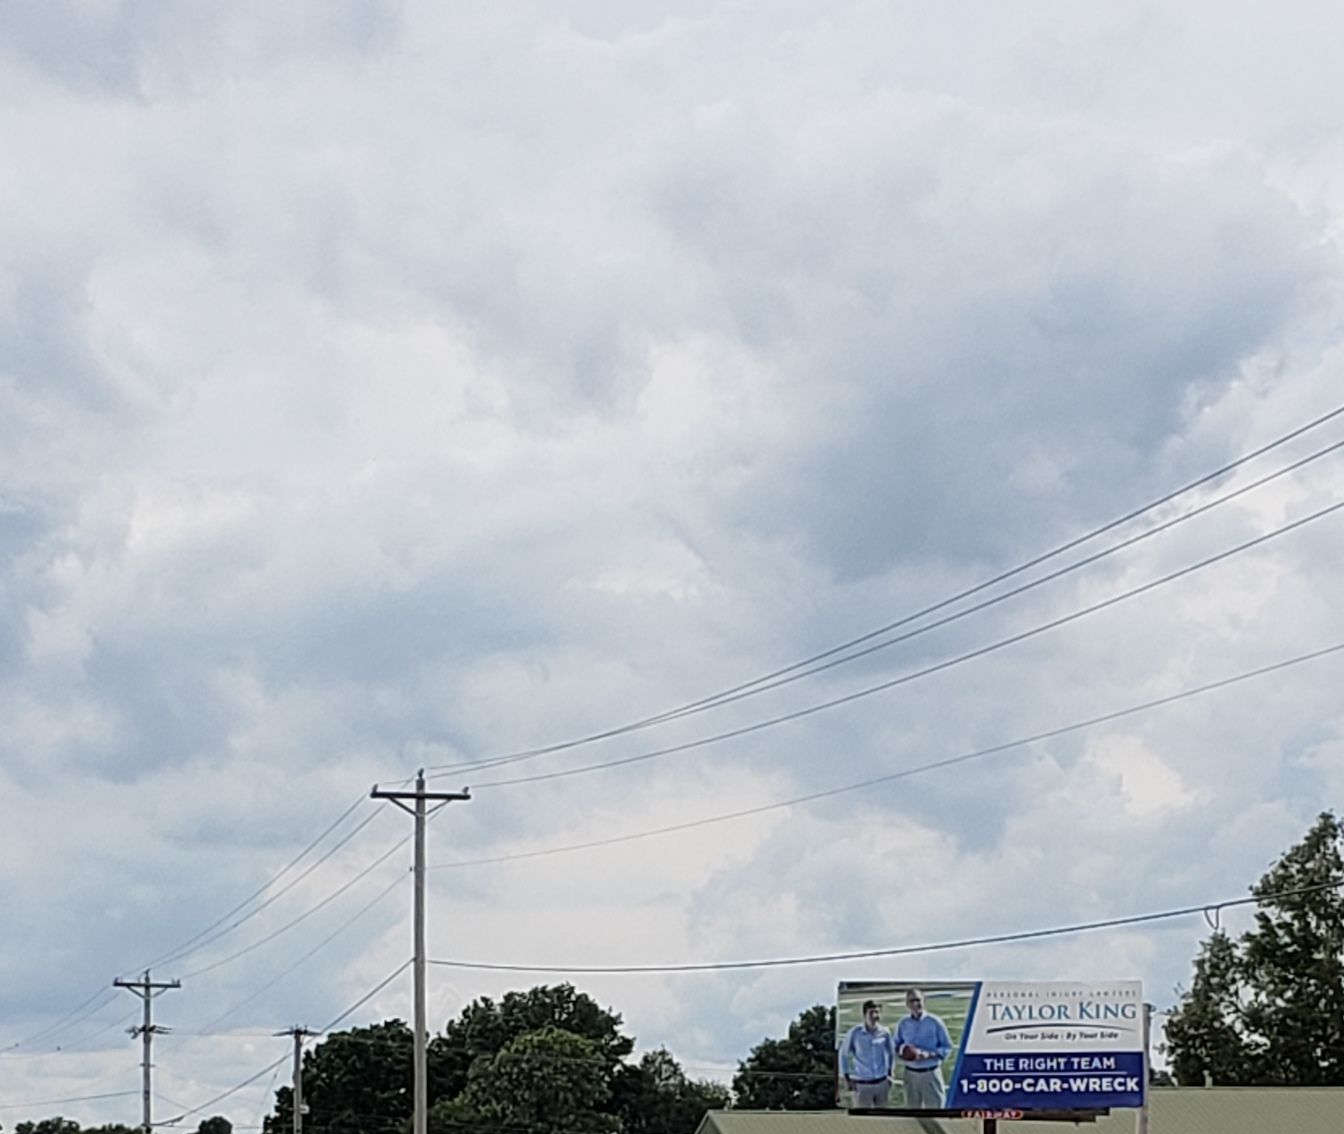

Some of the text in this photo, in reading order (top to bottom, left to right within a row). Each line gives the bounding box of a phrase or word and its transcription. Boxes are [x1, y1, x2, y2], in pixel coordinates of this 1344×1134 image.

[986, 1001, 1136, 1020] TAYLOR KING
[1040, 1032, 1058, 1040] Side
[983, 1056, 1116, 1071] THE RIGHT TEAM
[960, 1077, 1139, 1093] 1-800-CAR-WRECK
